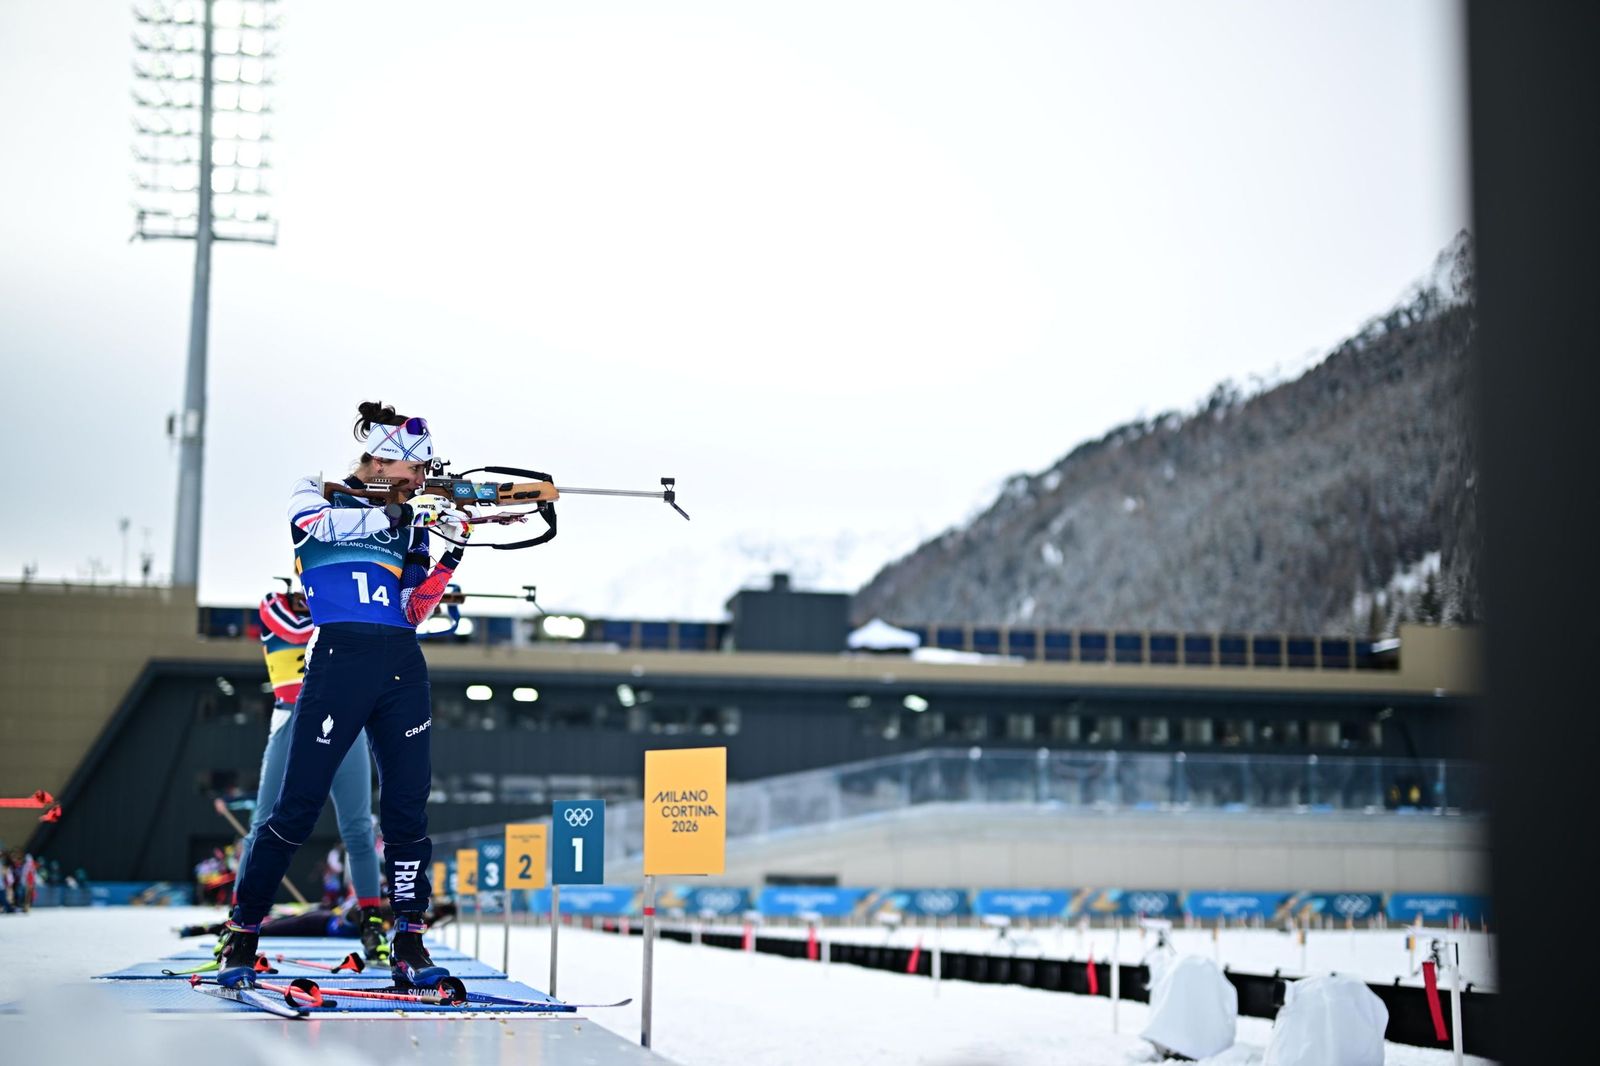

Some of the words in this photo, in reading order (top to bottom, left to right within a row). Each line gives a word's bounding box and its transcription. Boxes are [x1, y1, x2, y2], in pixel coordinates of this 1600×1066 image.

[364, 543, 393, 555] CORTINA
[652, 789, 709, 804] MILANO
[661, 805, 719, 818] CORTINA
[672, 820, 699, 833] 2026
[571, 837, 584, 873] 1
[484, 862, 500, 887] 3
[518, 854, 533, 880] 2
